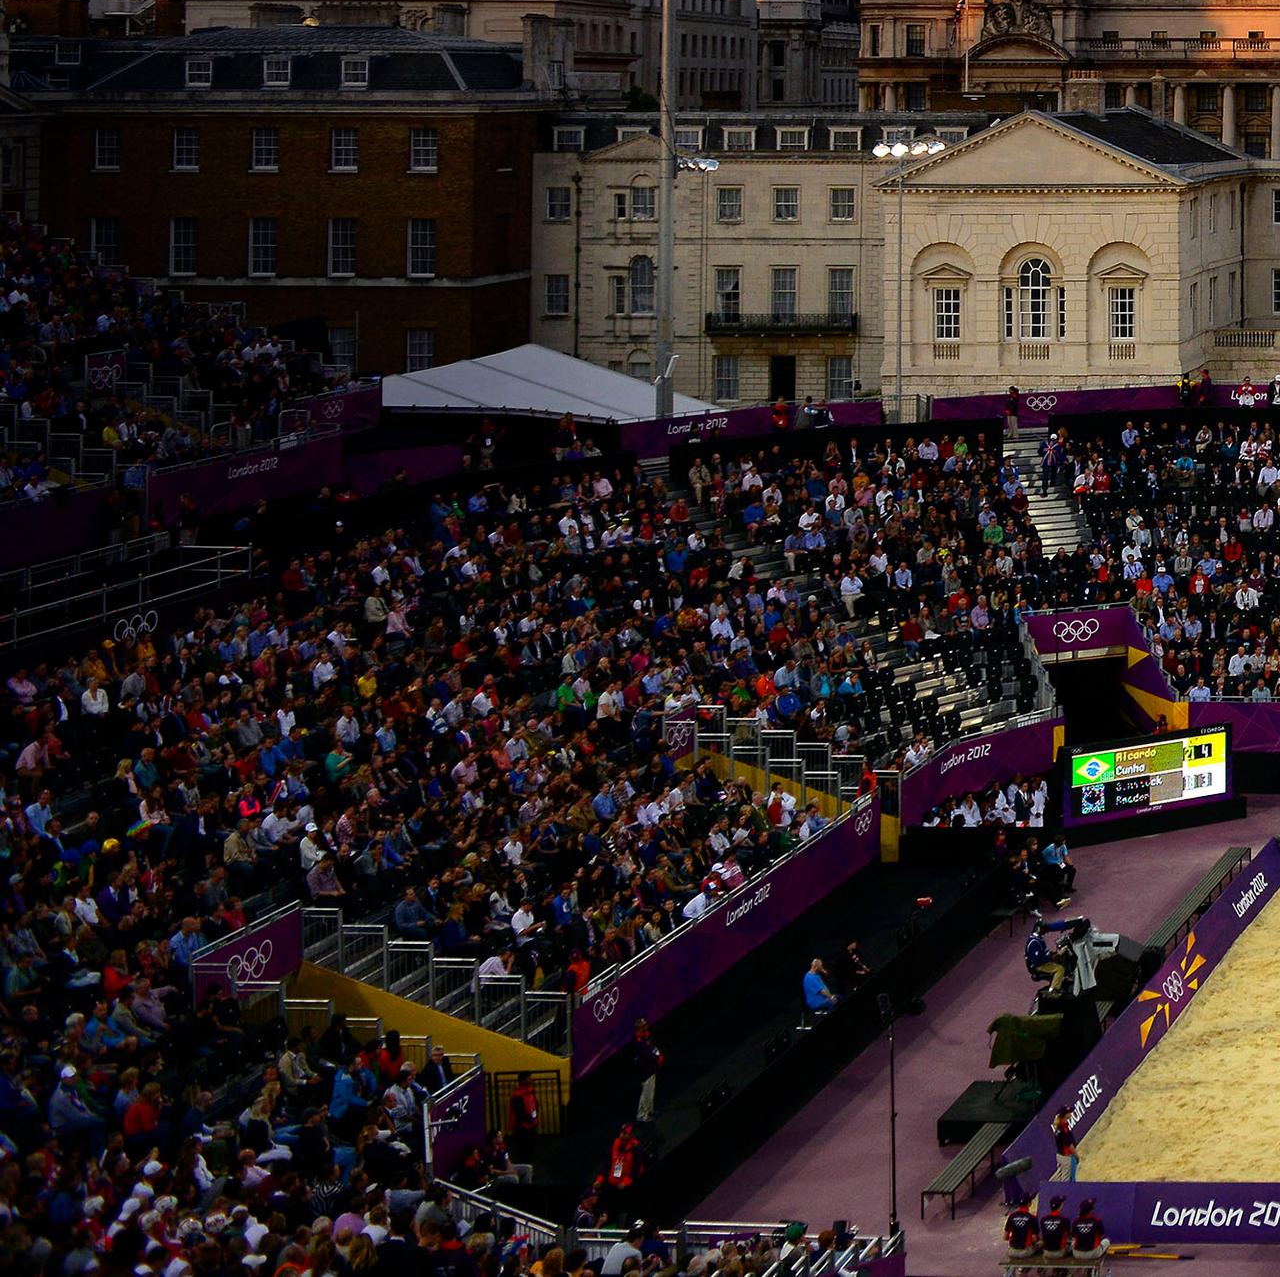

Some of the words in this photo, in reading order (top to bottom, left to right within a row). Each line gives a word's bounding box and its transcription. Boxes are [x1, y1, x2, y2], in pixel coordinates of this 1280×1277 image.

[667, 421, 704, 435] Londn
[227, 462, 259, 479] London
[259, 457, 279, 472] 2012
[940, 753, 966, 775] London
[967, 743, 992, 761] 2012
[1201, 743, 1209, 758] 4
[726, 898, 754, 927] London
[754, 882, 772, 906] 2012
[1232, 890, 1257, 918] London
[1250, 872, 1268, 896] 2012
[1078, 1074, 1103, 1109] 2012
[1150, 1200, 1244, 1227] London
